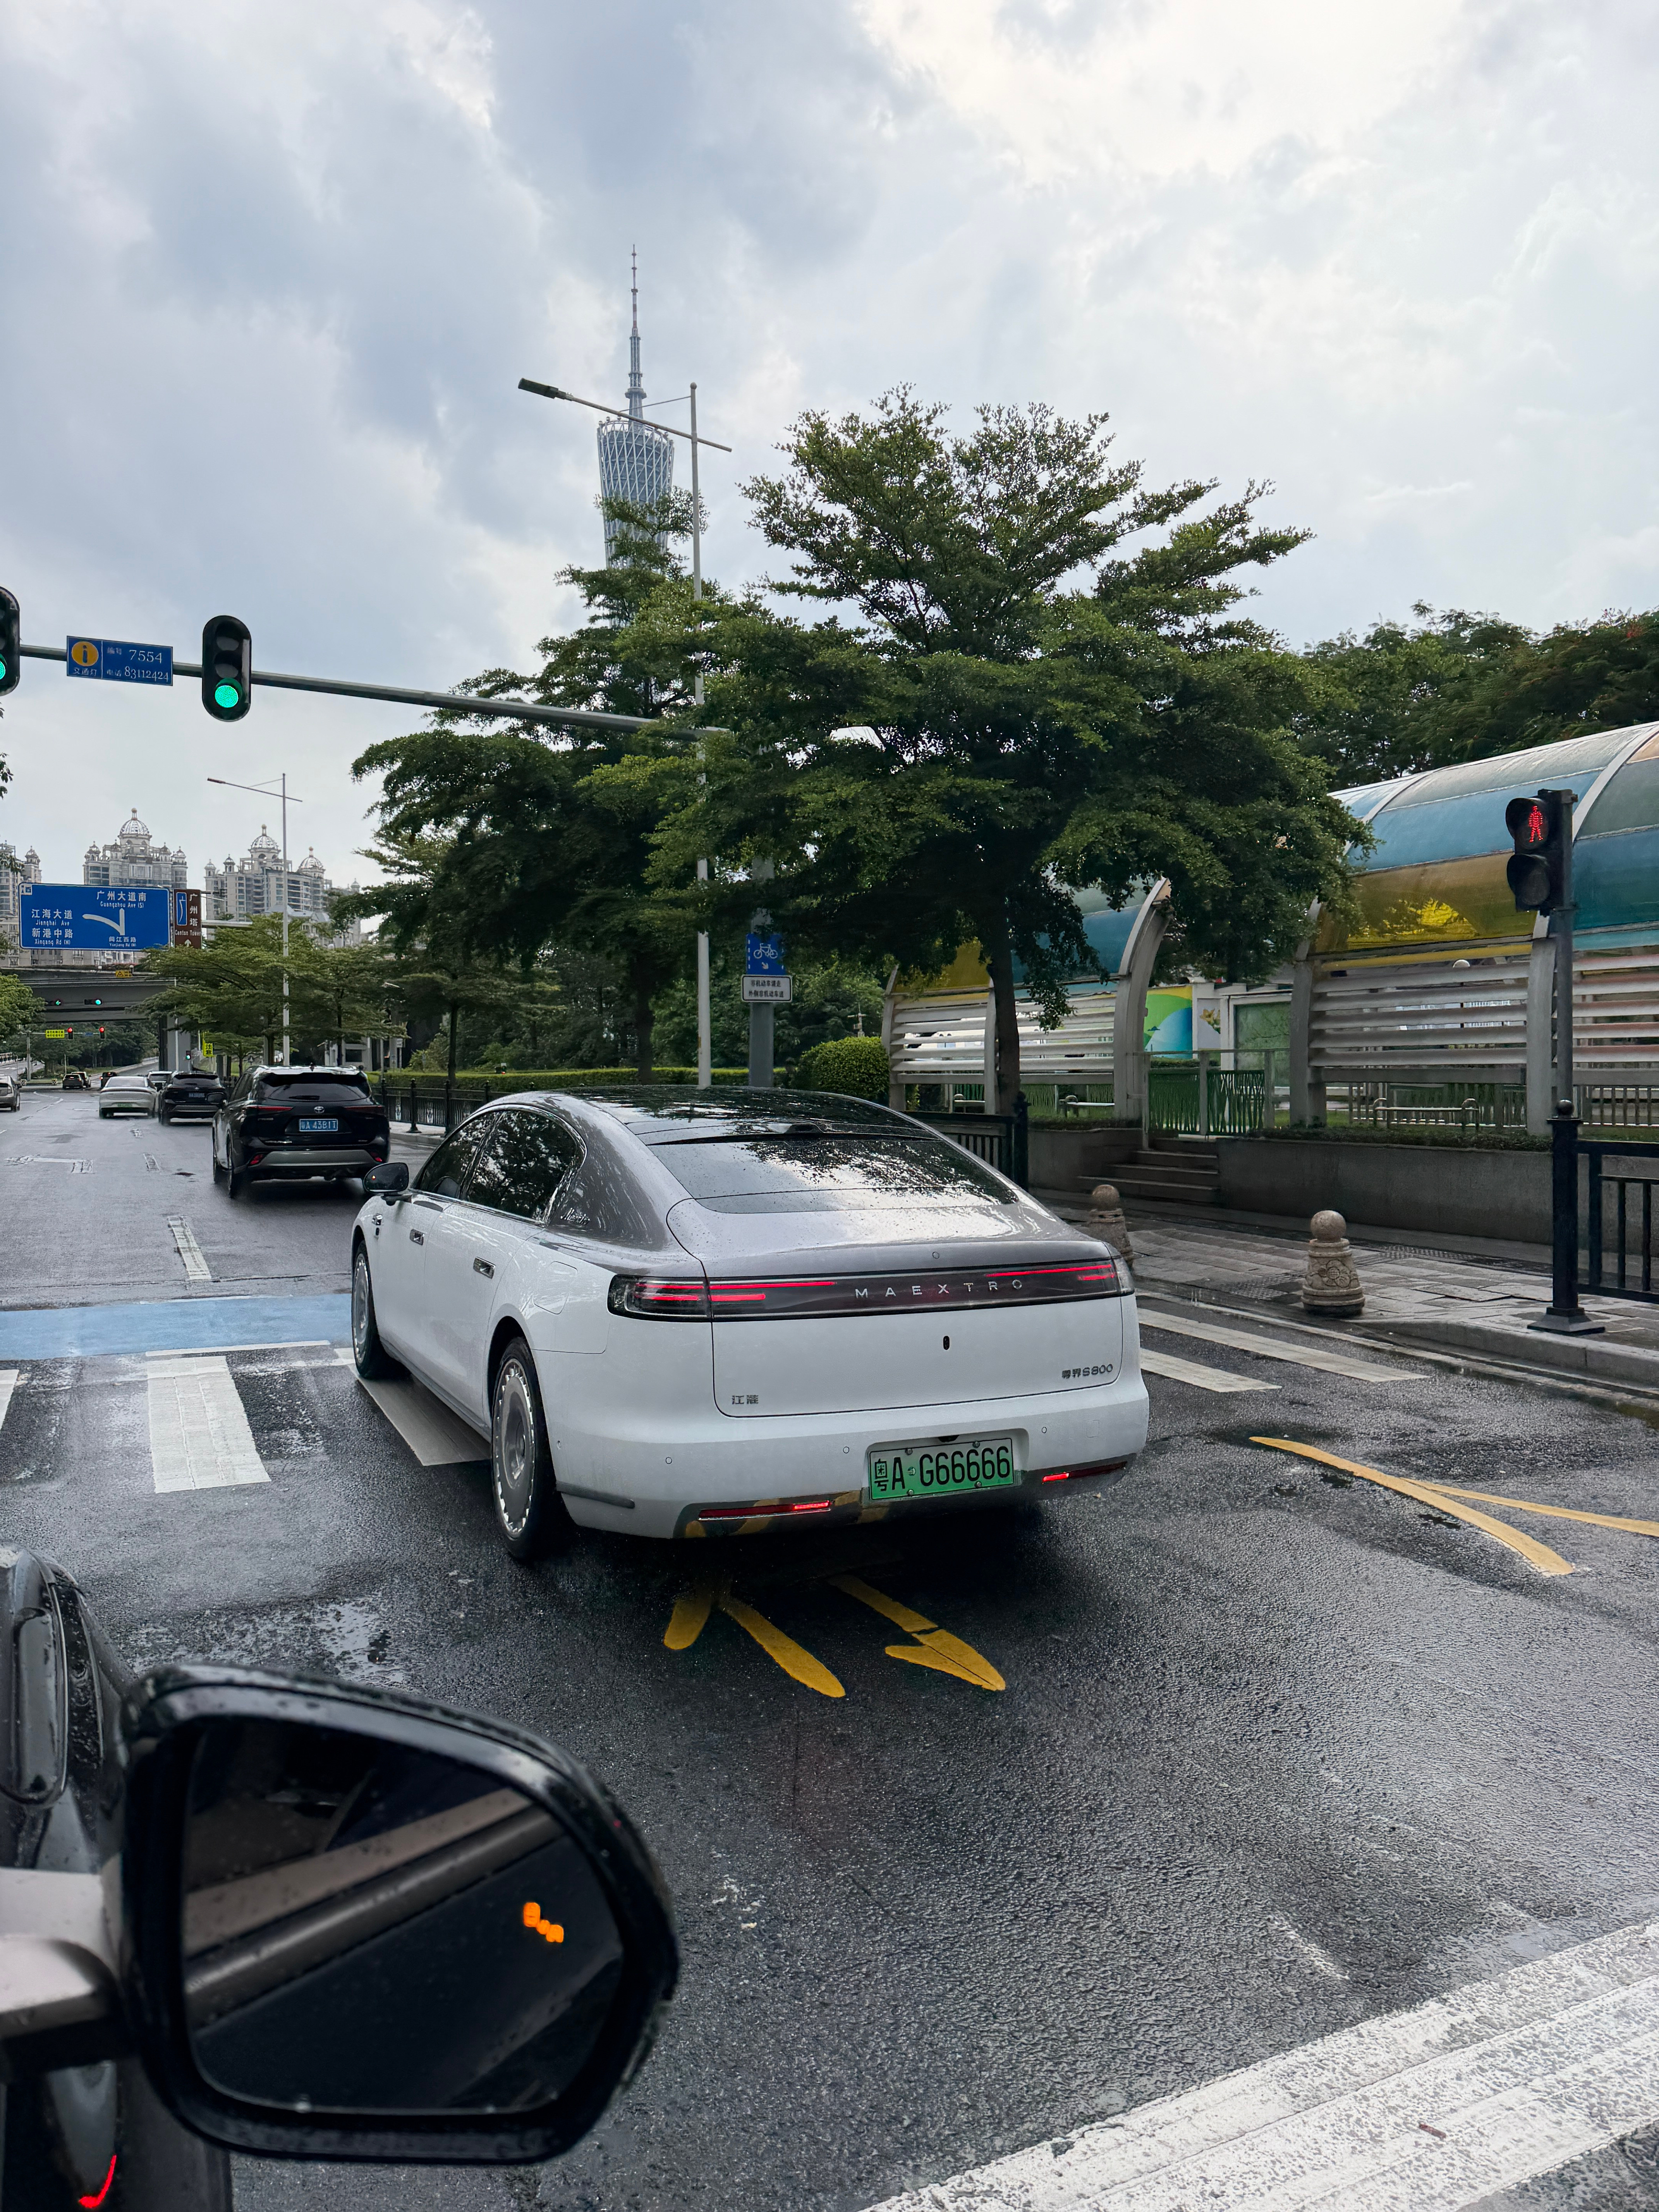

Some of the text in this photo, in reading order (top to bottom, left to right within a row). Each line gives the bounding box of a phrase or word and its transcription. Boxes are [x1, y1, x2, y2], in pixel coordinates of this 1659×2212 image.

[129, 649, 162, 663] 7554
[125, 666, 168, 682] 83112424
[97, 890, 146, 902] 广州大道南
[31, 908, 73, 919] 江海大道
[189, 893, 198, 926] 广州塔
[32, 928, 73, 938] 新港中路
[855, 1279, 1022, 1298] MAEXTRO
